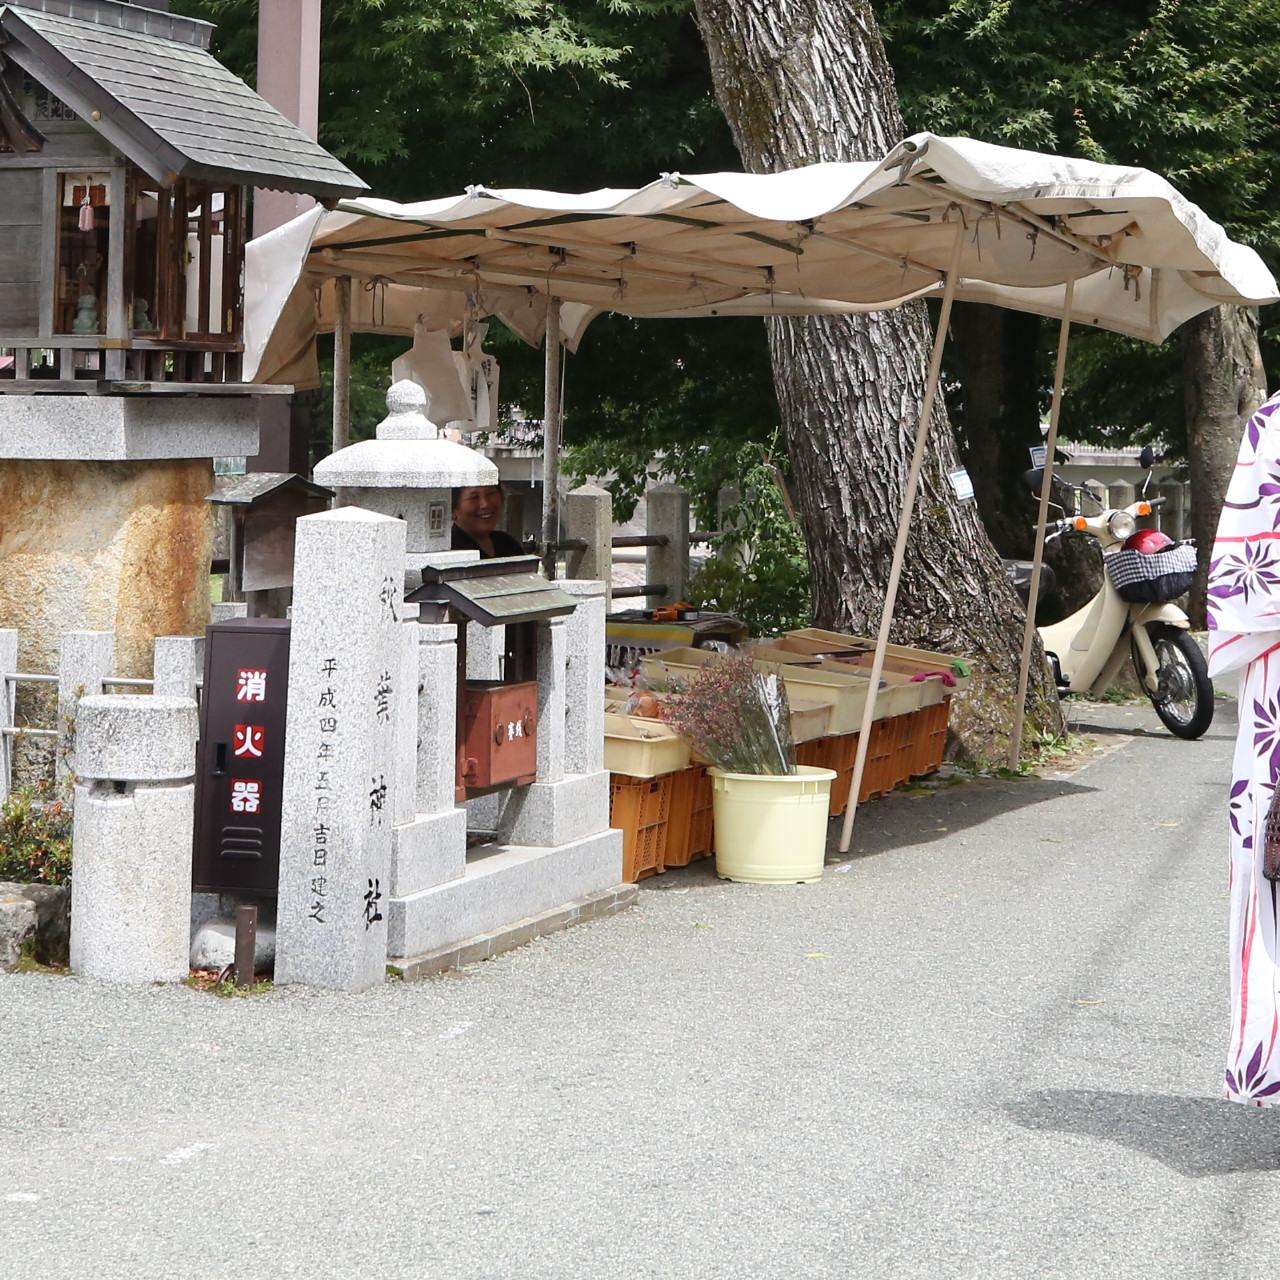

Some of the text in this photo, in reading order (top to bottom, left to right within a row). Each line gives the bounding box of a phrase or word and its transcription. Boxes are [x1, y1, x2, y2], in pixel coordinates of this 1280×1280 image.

[231, 671, 267, 813] 消火器
[308, 658, 337, 924] 平成四年五月吉日建之
